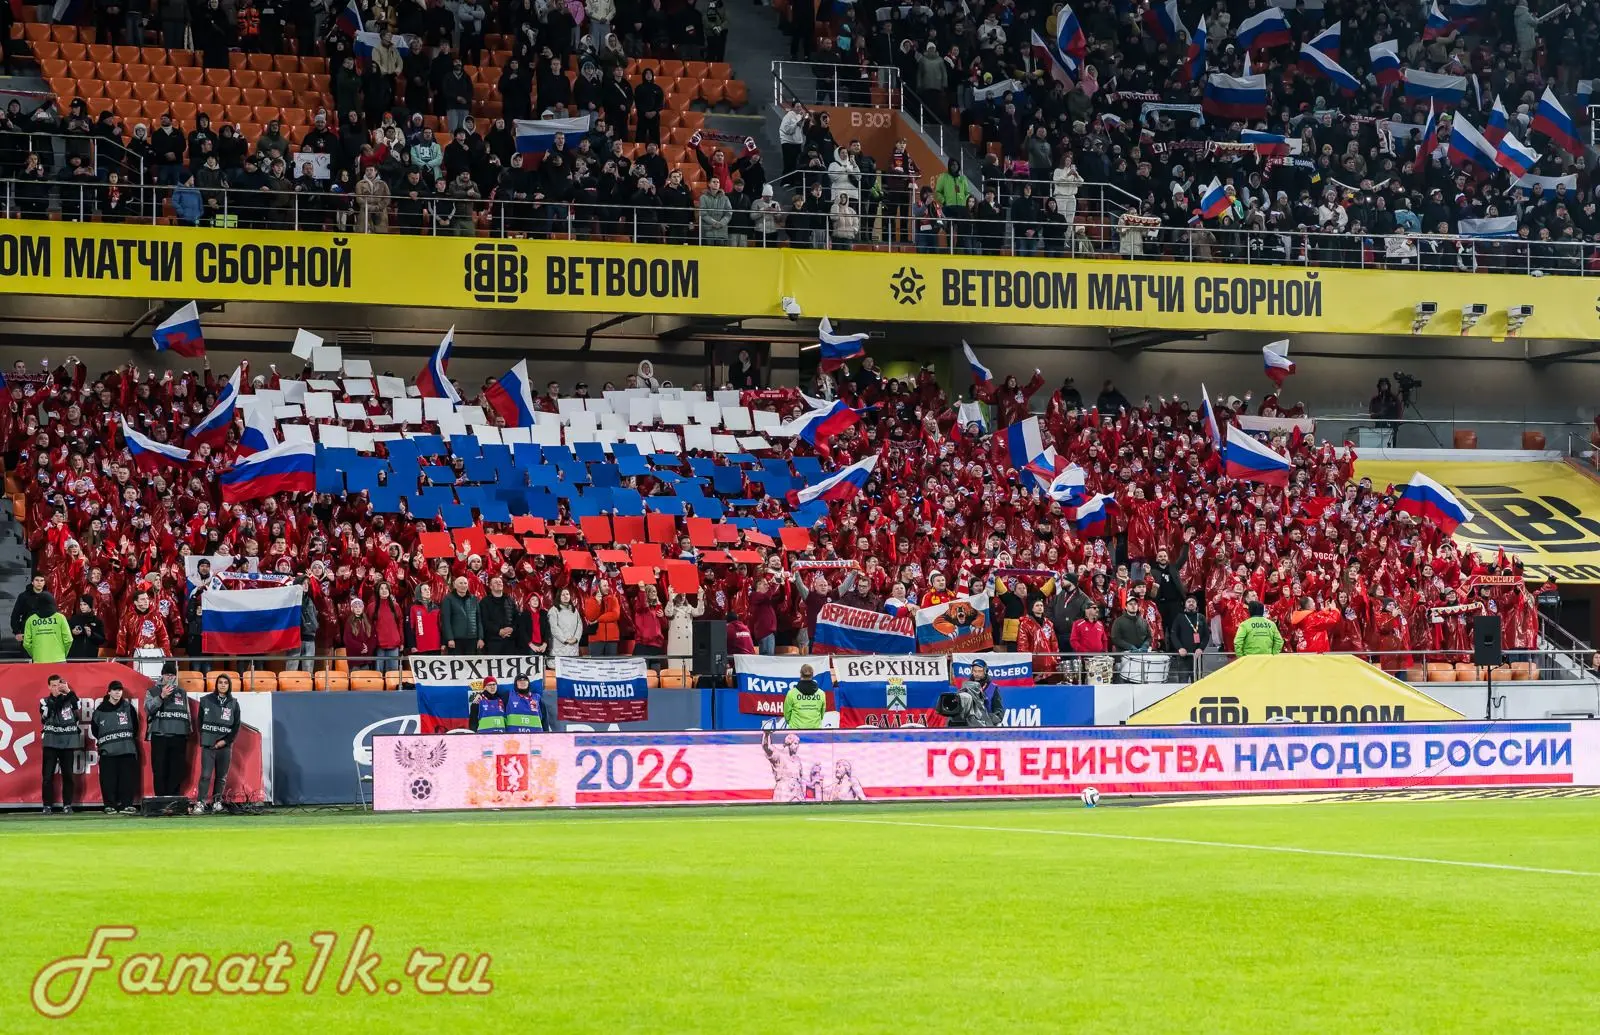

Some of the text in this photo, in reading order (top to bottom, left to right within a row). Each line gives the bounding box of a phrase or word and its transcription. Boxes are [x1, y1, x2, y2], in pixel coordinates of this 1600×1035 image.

[851, 112, 891, 128] B 303
[65, 237, 183, 282] МАТЧИ
[195, 238, 352, 288] СБОРНОЙ
[547, 255, 699, 298] BETBOOM
[943, 269, 1322, 317] BETBOOM МАТЧИ СБОРНОЙ
[32, 618, 58, 626] 00631
[414, 657, 540, 681] ВЕРХНЯЯ
[848, 660, 940, 677] ВЕРХНЯЯ
[958, 665, 1030, 679] АФАСЬЕВО
[757, 701, 784, 713] АФАН
[576, 748, 693, 790] 2026
[926, 738, 1572, 781] ГОД ЕДИНСТВА НАРОДОВ РОССИИ
